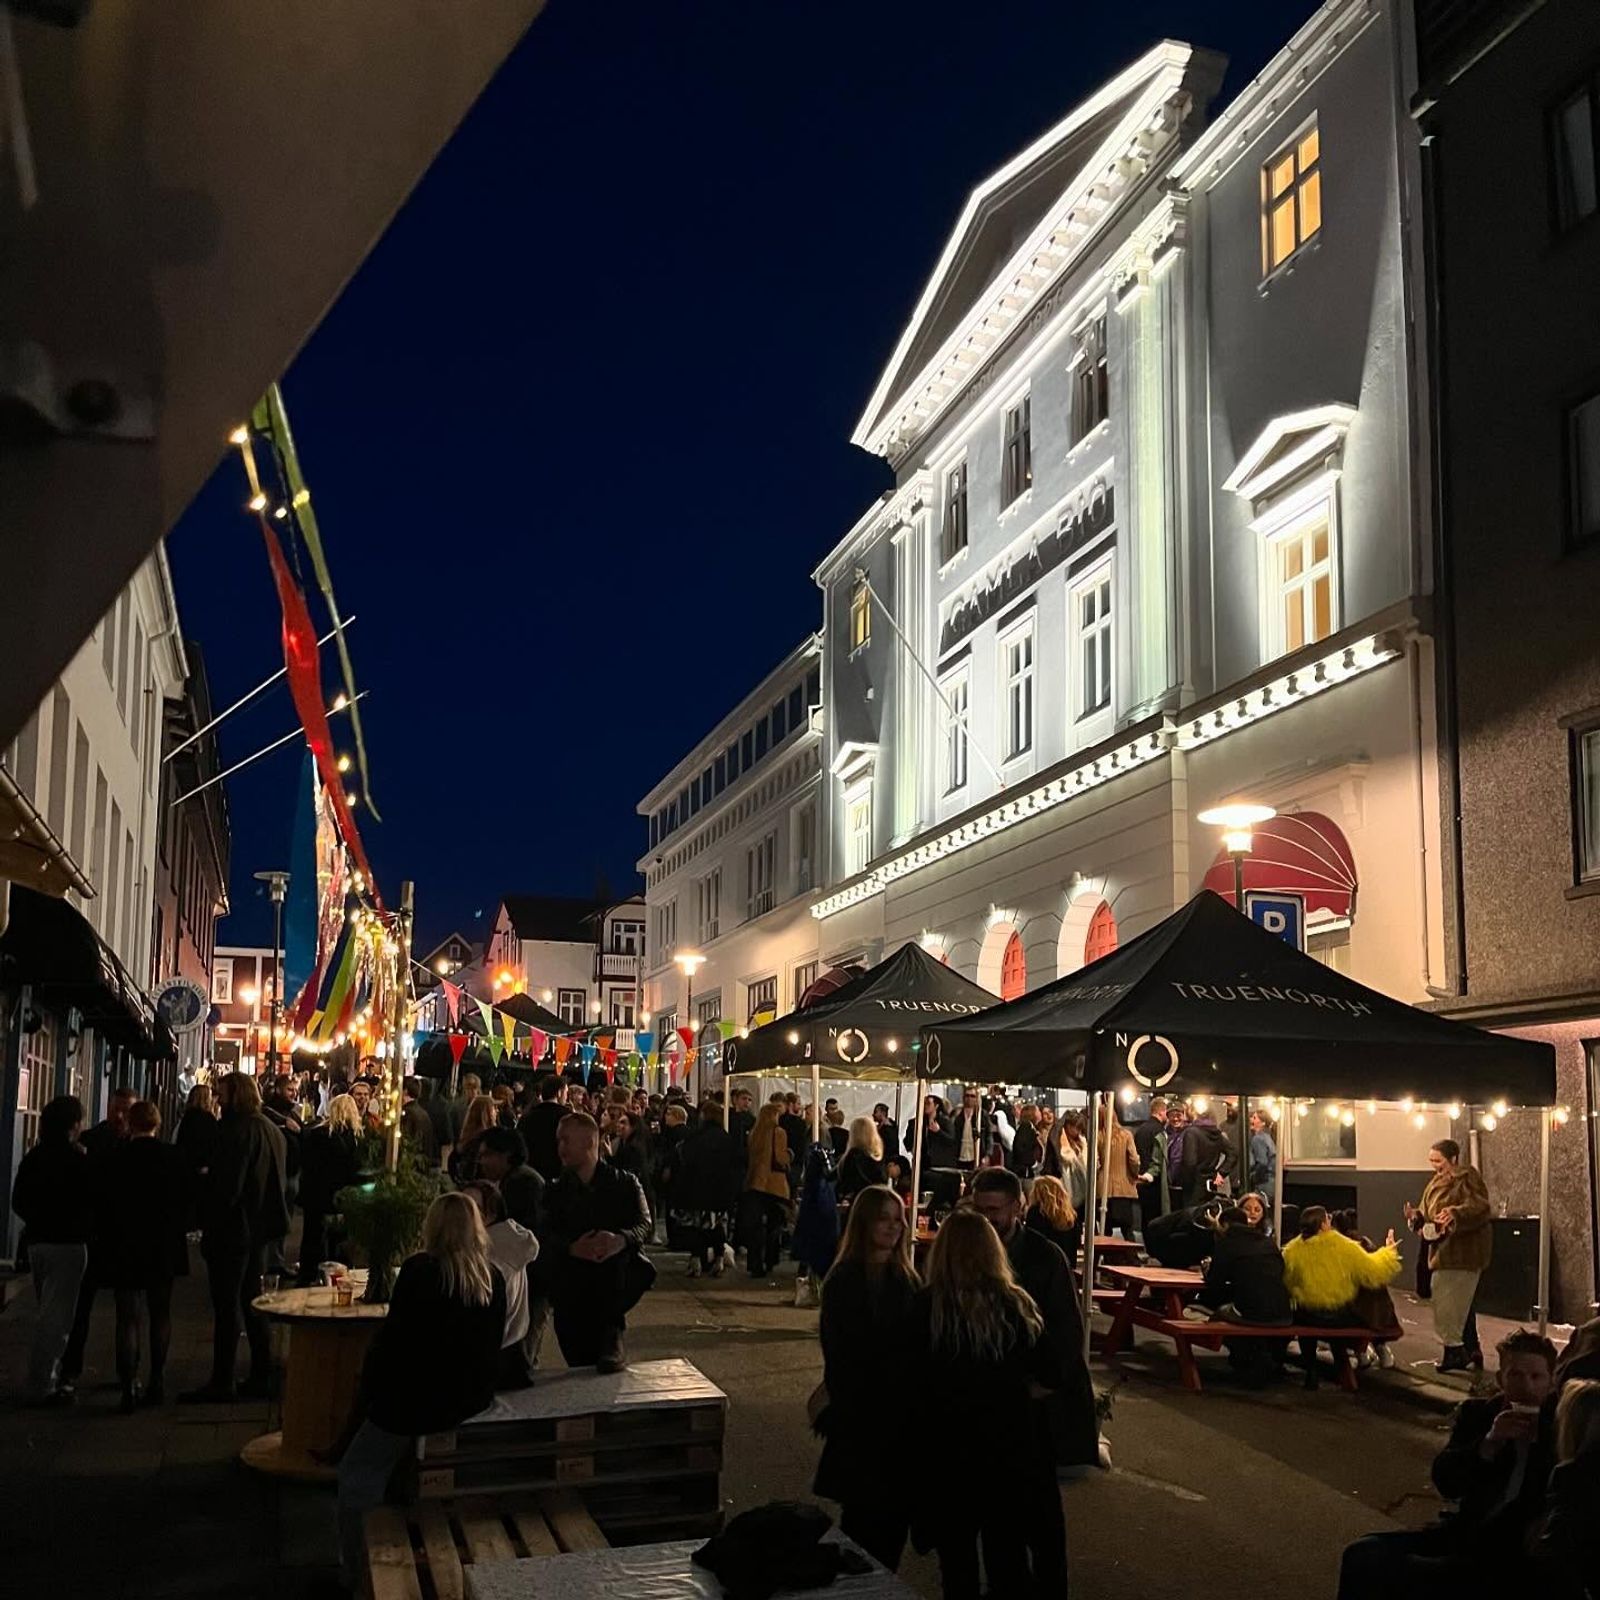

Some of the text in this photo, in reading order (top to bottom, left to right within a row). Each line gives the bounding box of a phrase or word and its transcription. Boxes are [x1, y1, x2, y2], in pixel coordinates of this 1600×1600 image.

[876, 999, 988, 1015] TRUENOR
[1170, 981, 1373, 1018] TRUENORTH
[828, 1026, 838, 1038] N
[1115, 1032, 1128, 1047] N
